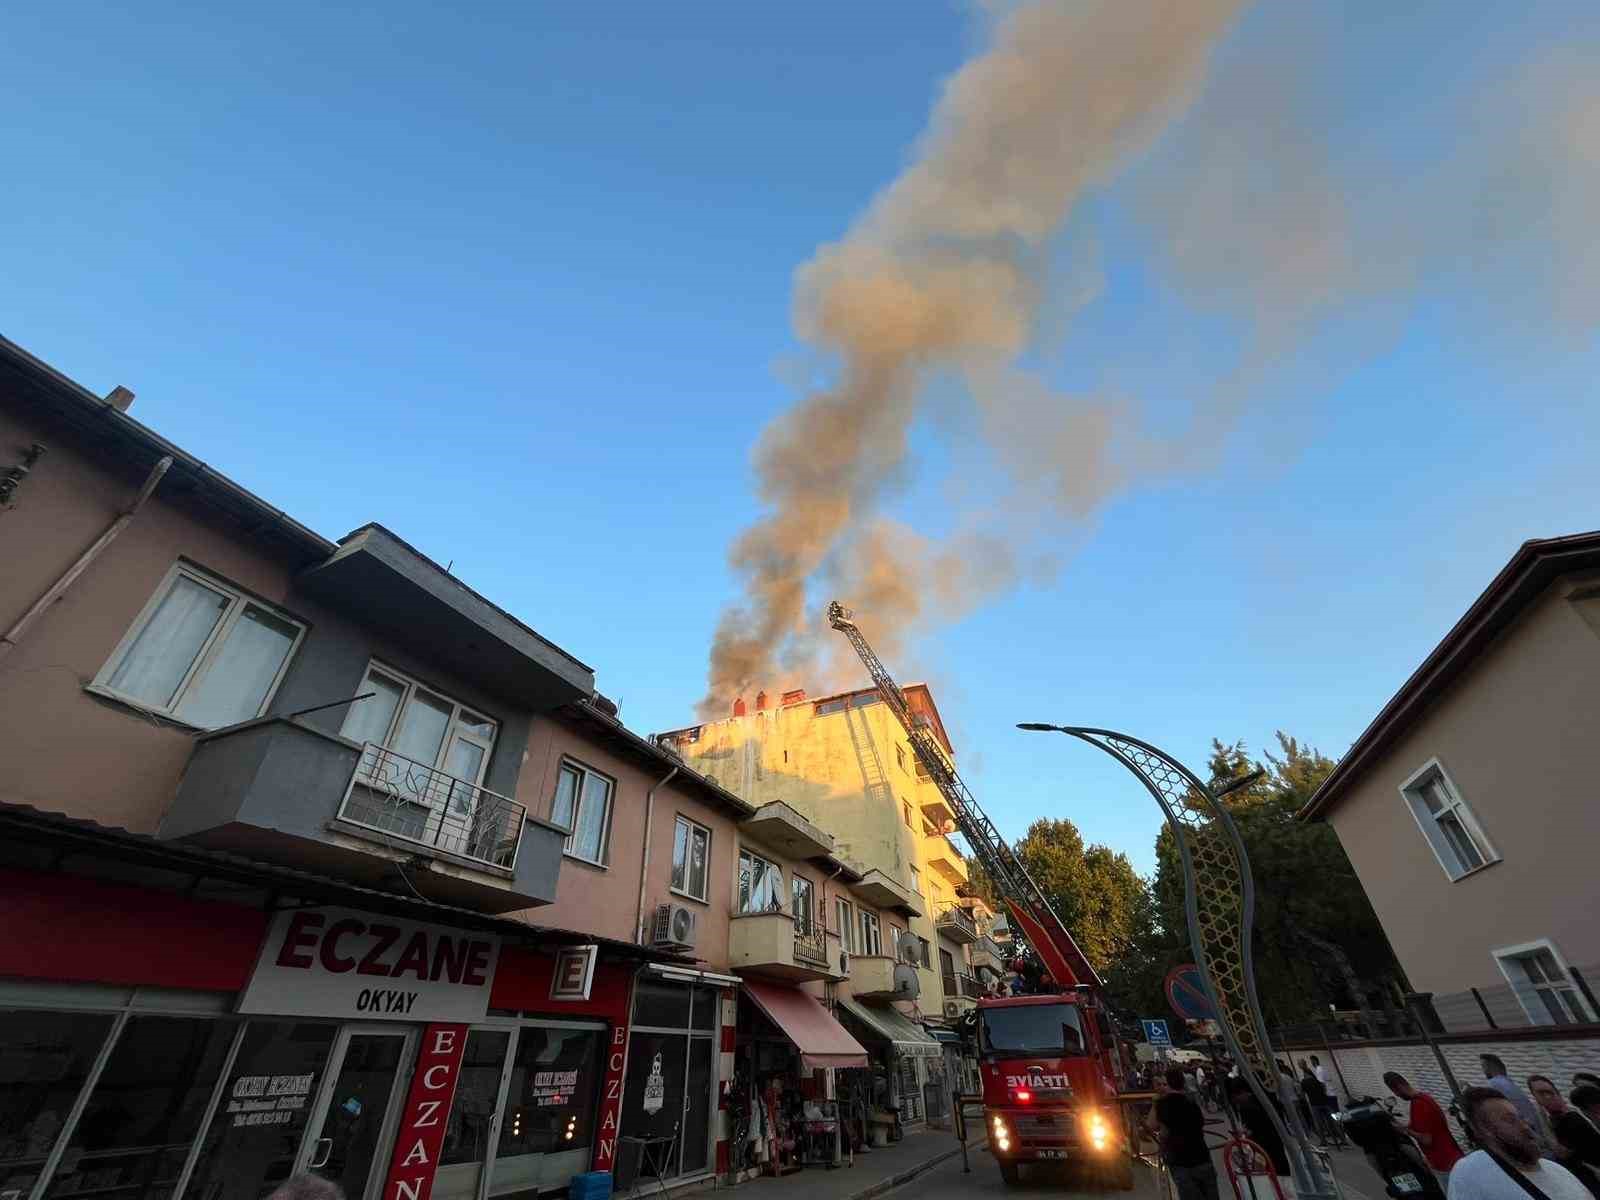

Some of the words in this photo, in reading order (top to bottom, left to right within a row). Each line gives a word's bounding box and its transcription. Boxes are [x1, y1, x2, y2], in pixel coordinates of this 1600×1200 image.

[276, 911, 491, 986] ECZANE
[560, 955, 584, 990] E
[357, 990, 417, 1013] OKYAY
[597, 1027, 625, 1173] ECZAN
